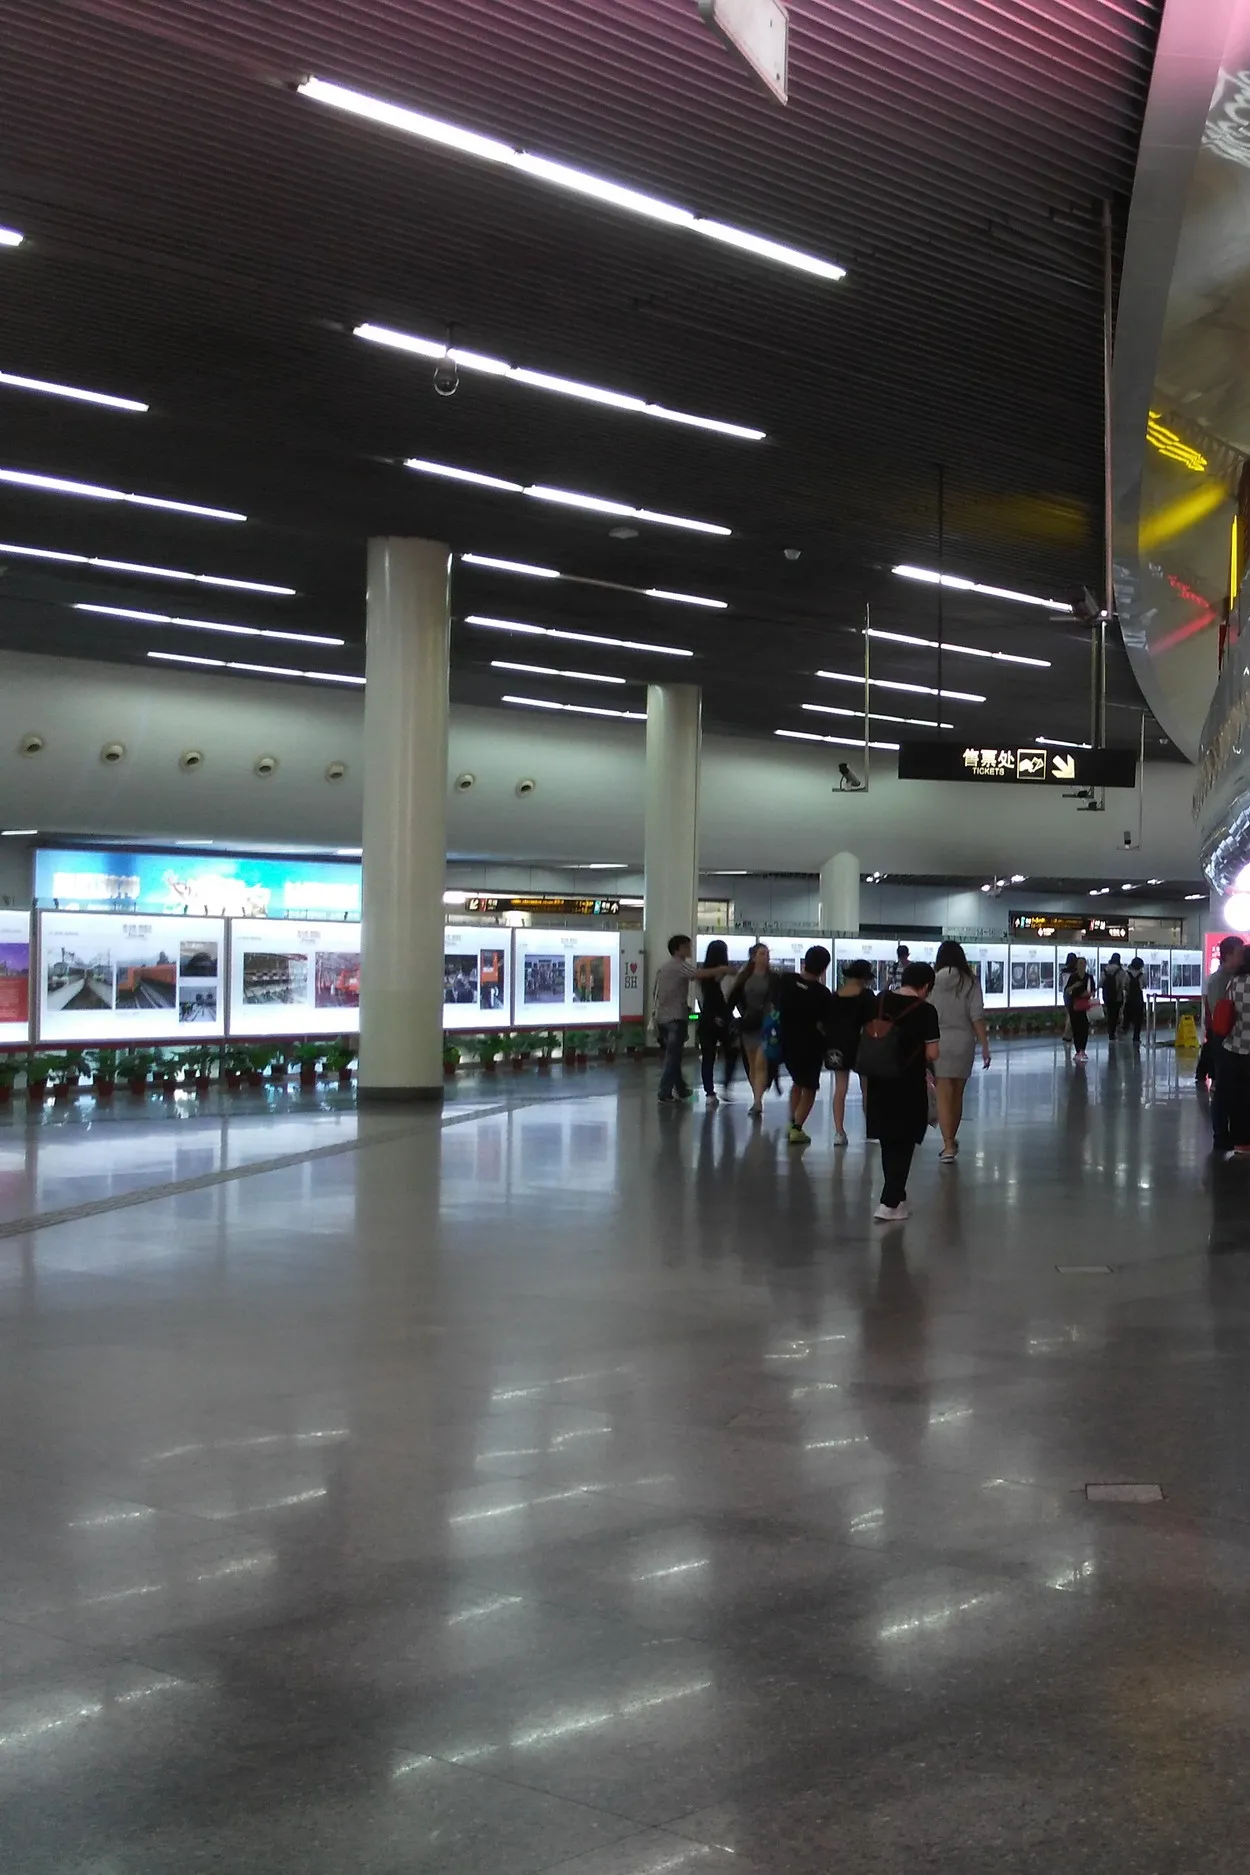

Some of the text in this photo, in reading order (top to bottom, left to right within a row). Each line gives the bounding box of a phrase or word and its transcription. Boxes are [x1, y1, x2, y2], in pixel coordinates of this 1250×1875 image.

[962, 748, 1015, 768] 售票处
[972, 767, 1005, 776] TICKETS
[624, 976, 638, 989] SH
